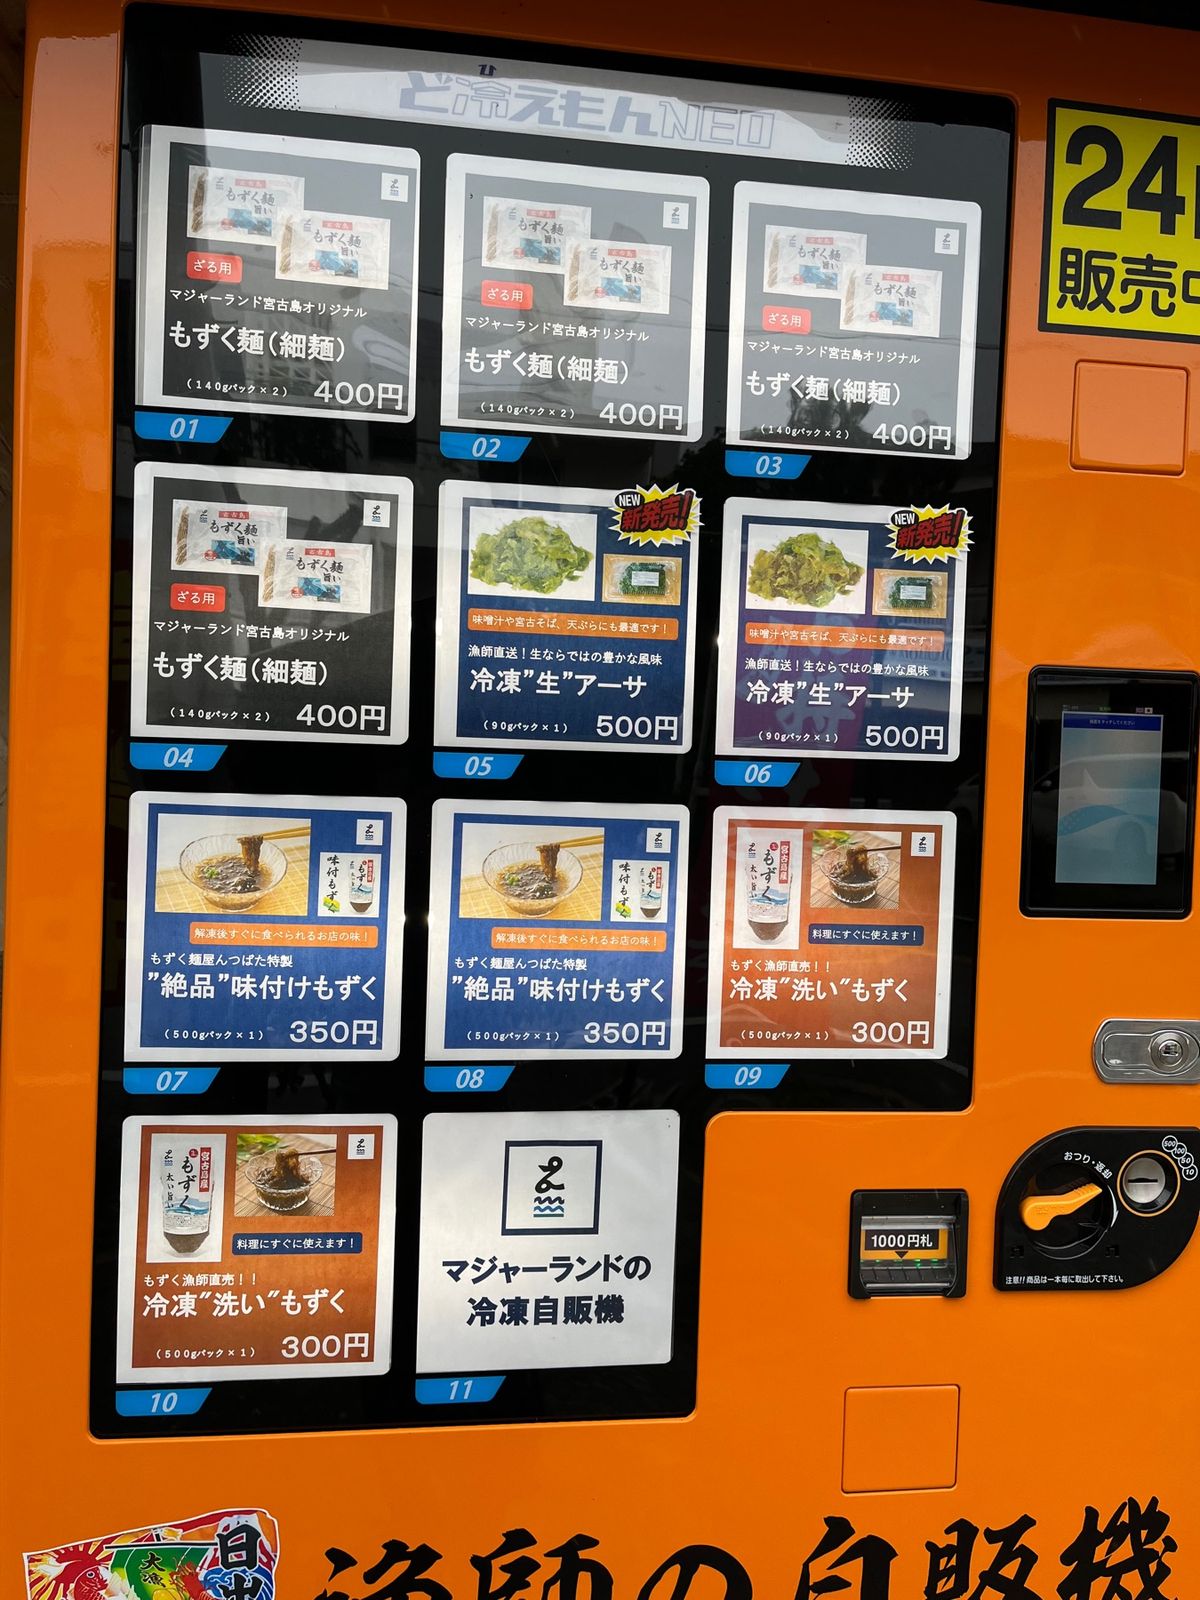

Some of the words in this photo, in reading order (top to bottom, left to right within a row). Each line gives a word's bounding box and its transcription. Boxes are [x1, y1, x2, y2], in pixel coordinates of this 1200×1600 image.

[1062, 125, 1200, 240] 24
[193, 258, 231, 274] ざる用
[169, 288, 367, 317] マジャーランド宮古島オリジナル
[487, 287, 523, 302] ざる用
[466, 317, 649, 341] マジャーランド宮古島オリジナル
[768, 313, 801, 328] ざる用
[169, 321, 345, 362] もずく麺(細麺)
[747, 342, 920, 365] マジャーランド宮古島オリジナル
[464, 347, 629, 384] もずく麺(細麺)
[314, 380, 403, 410] 400円
[746, 371, 900, 405] もずく麺(細麺)
[600, 403, 683, 430] 400円
[169, 418, 199, 439] 01
[873, 423, 951, 450] 400円
[472, 438, 501, 458] 02
[755, 456, 782, 476] 03
[618, 494, 641, 506] NEW
[621, 490, 690, 532] 新発売!
[895, 513, 915, 524] NEW
[210, 522, 258, 537] もずく麺
[896, 509, 962, 550] 新発売!
[237, 536, 255, 545] 旨い
[296, 559, 344, 574] もずく麺
[323, 573, 341, 582] 旨い
[177, 591, 215, 605] ざる用
[154, 621, 350, 642] マジャーランド宮古島オリジナル
[468, 644, 662, 665] 漁師直送!生ならではの豊かな風味
[153, 652, 328, 686] もずく麺(細麺)
[745, 658, 929, 677] 漁師直送!生ならではの豊かな風味
[296, 704, 386, 731] 400円
[596, 716, 678, 741] 500円
[865, 725, 944, 750] 500円
[164, 747, 194, 767] 04
[464, 756, 494, 776] 05
[745, 765, 771, 784] 06
[326, 855, 340, 914] 味付もずく
[760, 849, 776, 902] もずく
[618, 863, 631, 918] 味付もずく
[194, 927, 368, 941] 解凍後すぐに食べられるお店の味!
[495, 932, 658, 946] 解凍後すぐに食べられるお店の味!
[812, 929, 917, 941] 料理にすぐに使えます!
[151, 953, 293, 967] もずく麺屋んつばた特製
[455, 957, 587, 970] もずく麺屋んつばた特製
[290, 1020, 377, 1045] 350円
[584, 1021, 666, 1046] 350円
[852, 1021, 930, 1045] 300円
[156, 1071, 188, 1091] 07
[456, 1069, 485, 1088] 08
[734, 1067, 761, 1086] 09
[1064, 1152, 1112, 1179] おつり・返却
[178, 1156, 196, 1211] もずく
[237, 1237, 354, 1250] 料理にすぐに使えます!
[871, 1234, 933, 1247] 1000円札
[442, 1254, 652, 1284] マジャーランドの
[466, 1294, 625, 1327] 冷凍自販機
[282, 1332, 369, 1359] 300円
[449, 1380, 473, 1400] 11
[151, 1392, 177, 1413] 10
